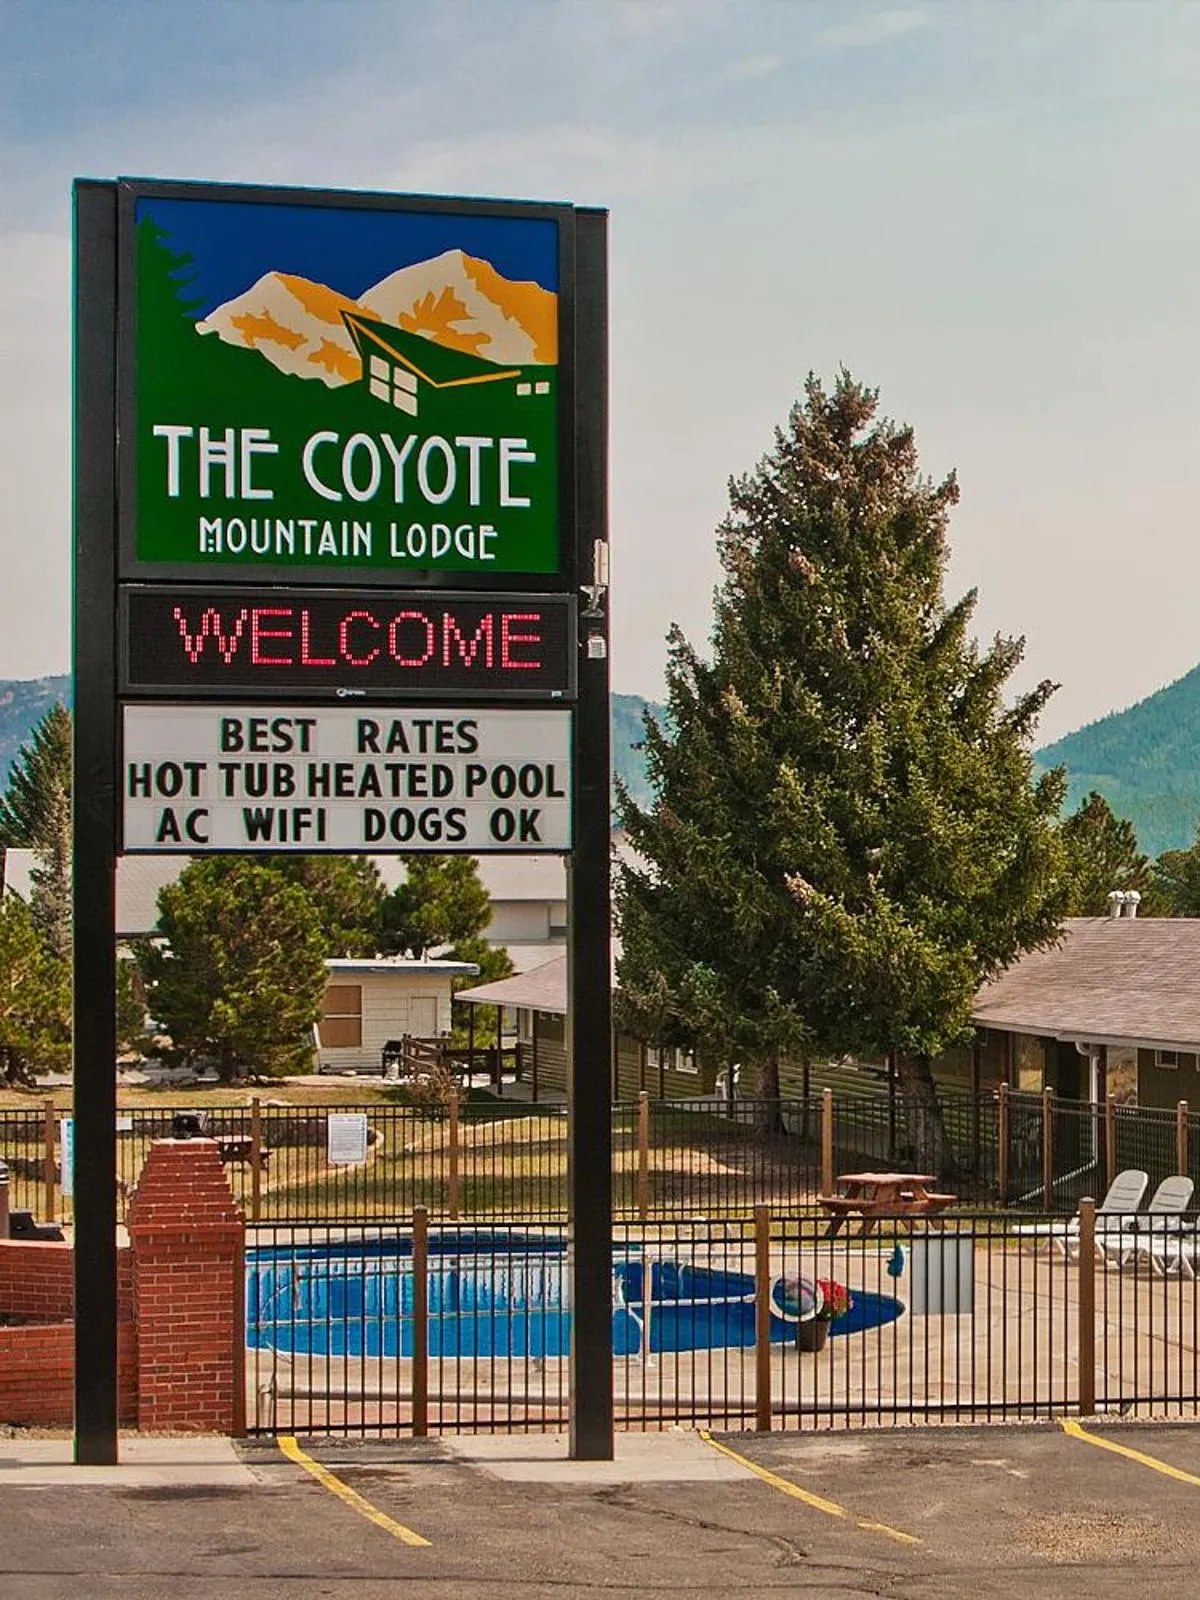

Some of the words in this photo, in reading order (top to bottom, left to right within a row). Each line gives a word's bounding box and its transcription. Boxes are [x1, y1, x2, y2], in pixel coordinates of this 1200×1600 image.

[153, 424, 280, 500] THE
[302, 430, 537, 508] COYOTE
[199, 516, 373, 557] MOUNTAIN
[390, 522, 499, 560] LODGE
[173, 606, 541, 669] WELCOME
[221, 717, 317, 753] BEST
[357, 718, 480, 755] RATES
[128, 761, 208, 798] HOT
[218, 762, 297, 798] TUB
[307, 762, 455, 798] HEATED
[465, 763, 565, 799] POOL
[156, 807, 209, 844] AC
[243, 807, 326, 842] WIFI
[364, 807, 468, 842] DOGS
[489, 807, 542, 842] OK
